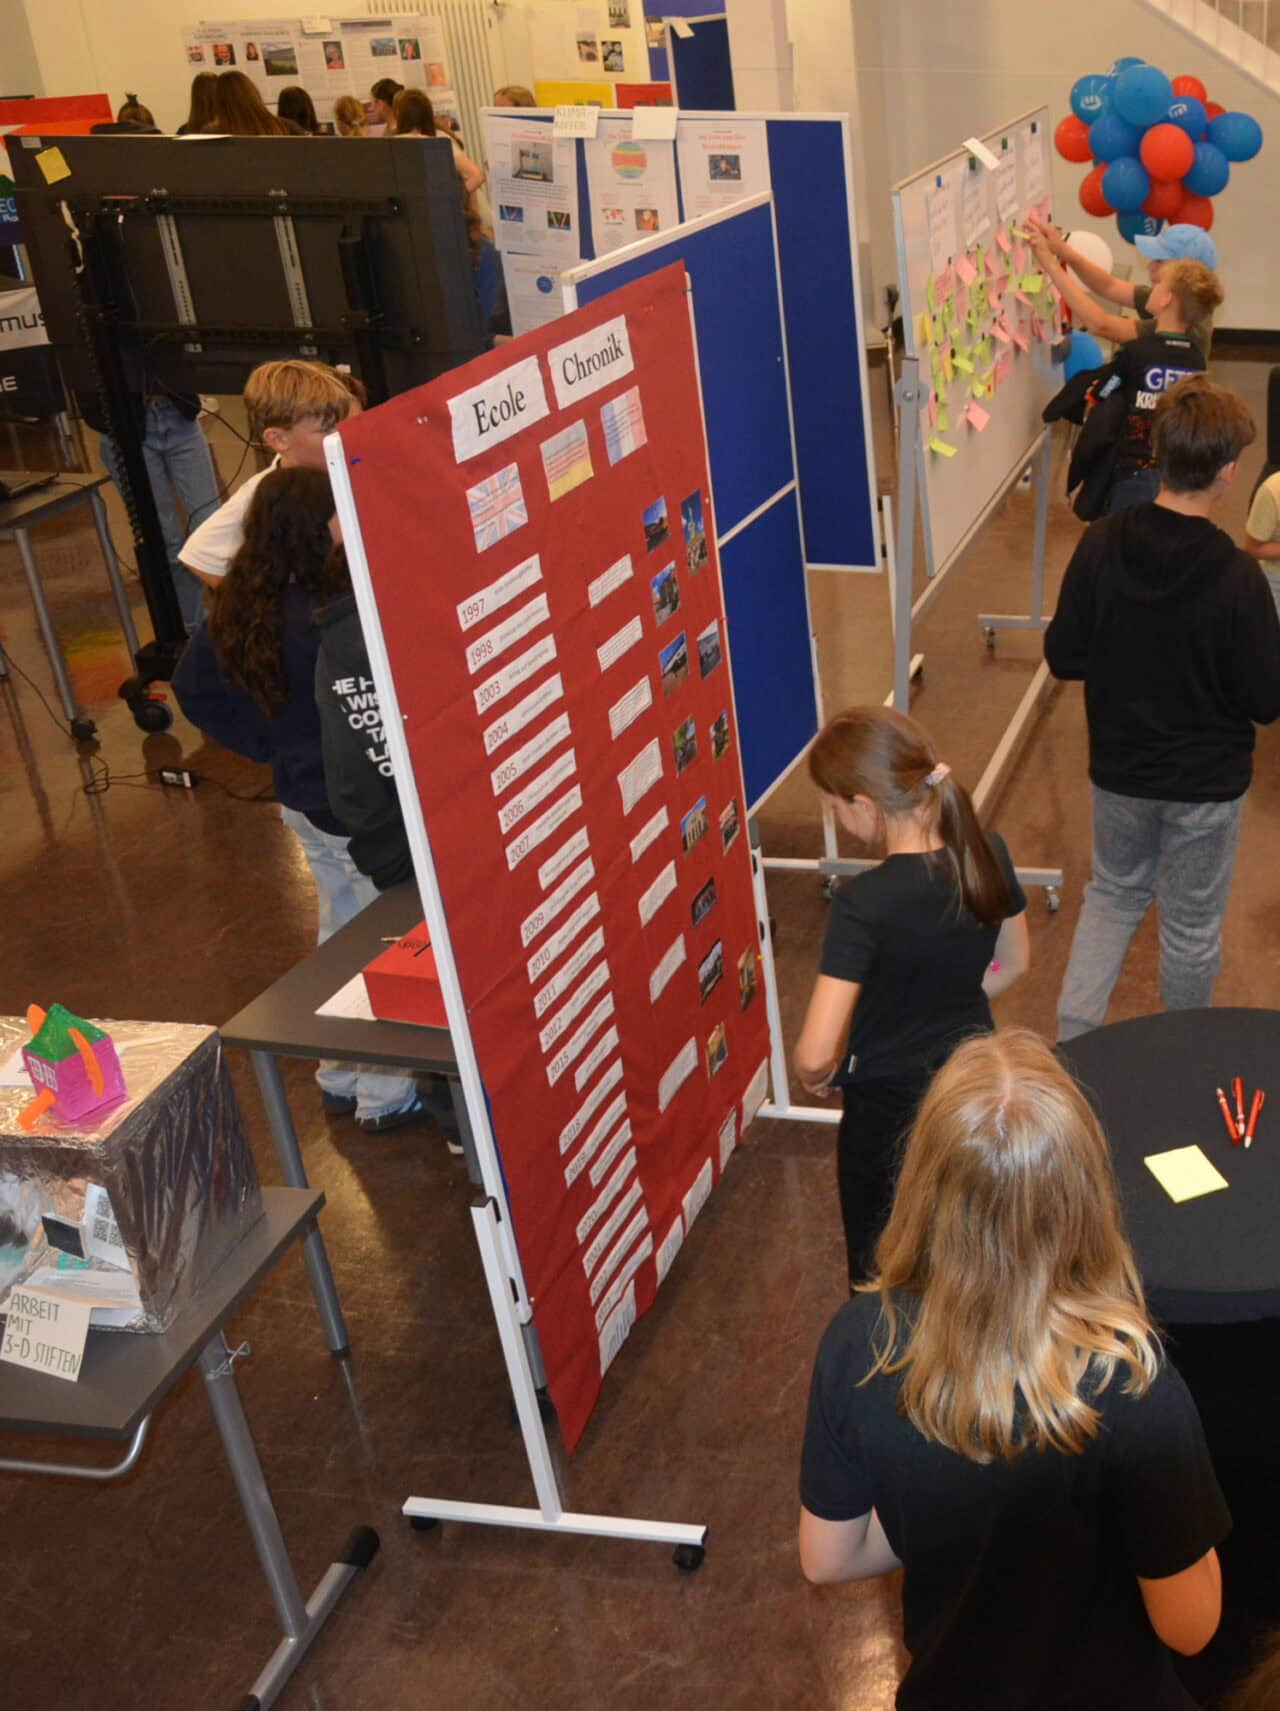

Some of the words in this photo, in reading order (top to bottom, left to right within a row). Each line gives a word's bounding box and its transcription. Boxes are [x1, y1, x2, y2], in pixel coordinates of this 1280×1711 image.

[562, 333, 625, 386] Chronik
[472, 384, 527, 437] Ecole
[462, 598, 485, 624] 1997
[471, 639, 494, 665] 1998
[480, 680, 501, 706] 2003
[488, 721, 509, 748] 2004
[497, 762, 518, 789] 2005
[511, 835, 529, 863] 2007
[532, 948, 551, 977] 2010
[10, 1293, 60, 1322] ARBEIT
[8, 1314, 32, 1336] MIT
[4, 1333, 30, 1359] 3-D
[34, 1342, 81, 1375] STIFTEN
